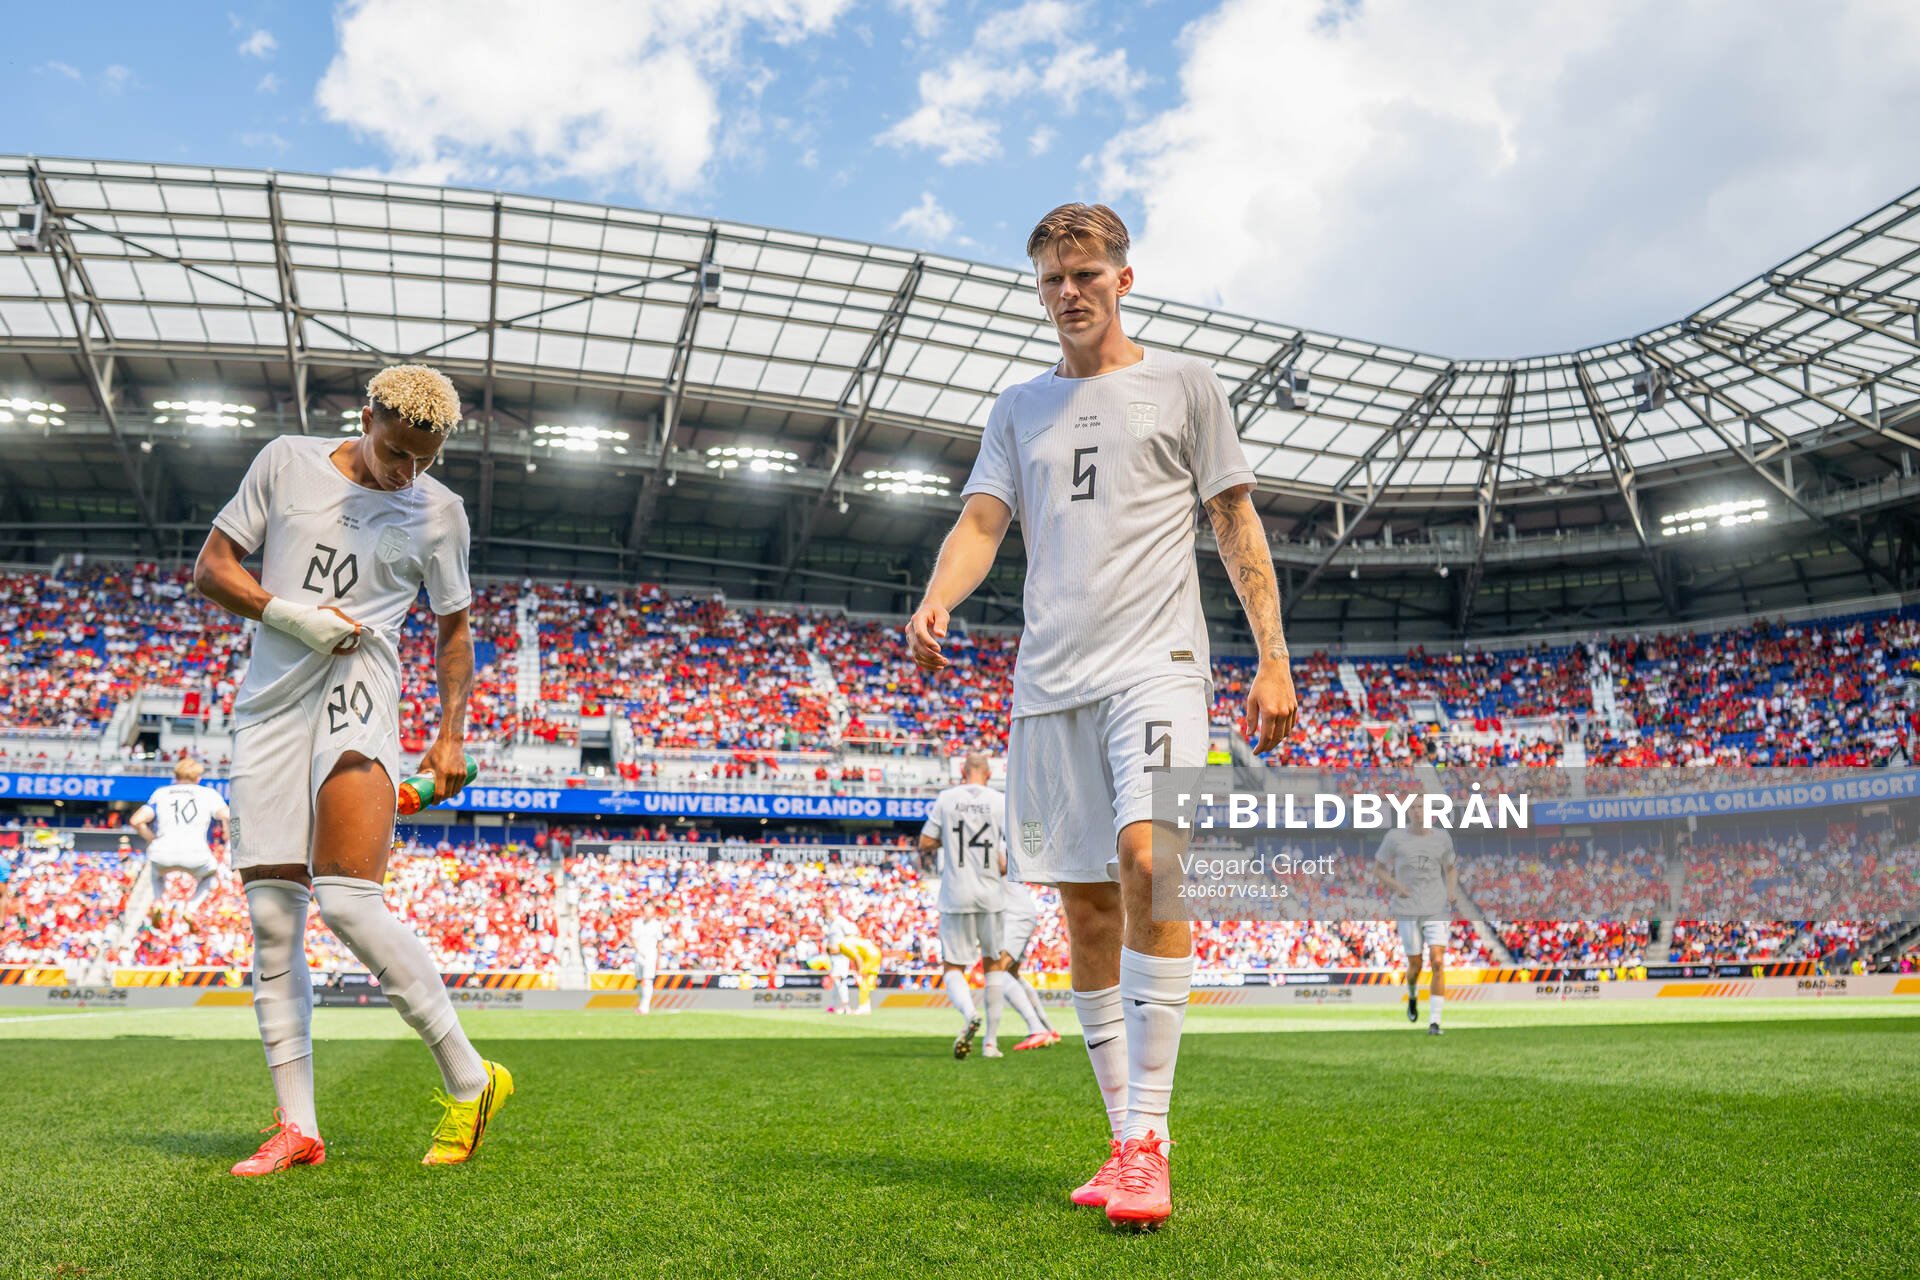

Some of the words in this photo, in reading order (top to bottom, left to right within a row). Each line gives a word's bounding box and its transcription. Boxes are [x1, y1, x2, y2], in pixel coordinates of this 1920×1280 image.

[1070, 446, 1099, 502] 5
[302, 542, 359, 599] 20
[327, 680, 374, 735] 20
[1143, 720, 1173, 774] 5
[16, 776, 115, 797] RESORT
[470, 789, 561, 809] RESORT
[644, 794, 769, 815] UNIVERSAL
[772, 797, 882, 817] ORLANDO
[885, 799, 936, 818] RESO
[1588, 792, 1711, 819] UNIVERSAL
[1714, 784, 1827, 811] ORLANDO
[1832, 774, 1917, 801] RESORT
[170, 798, 198, 825] 10
[952, 819, 993, 869] 14
